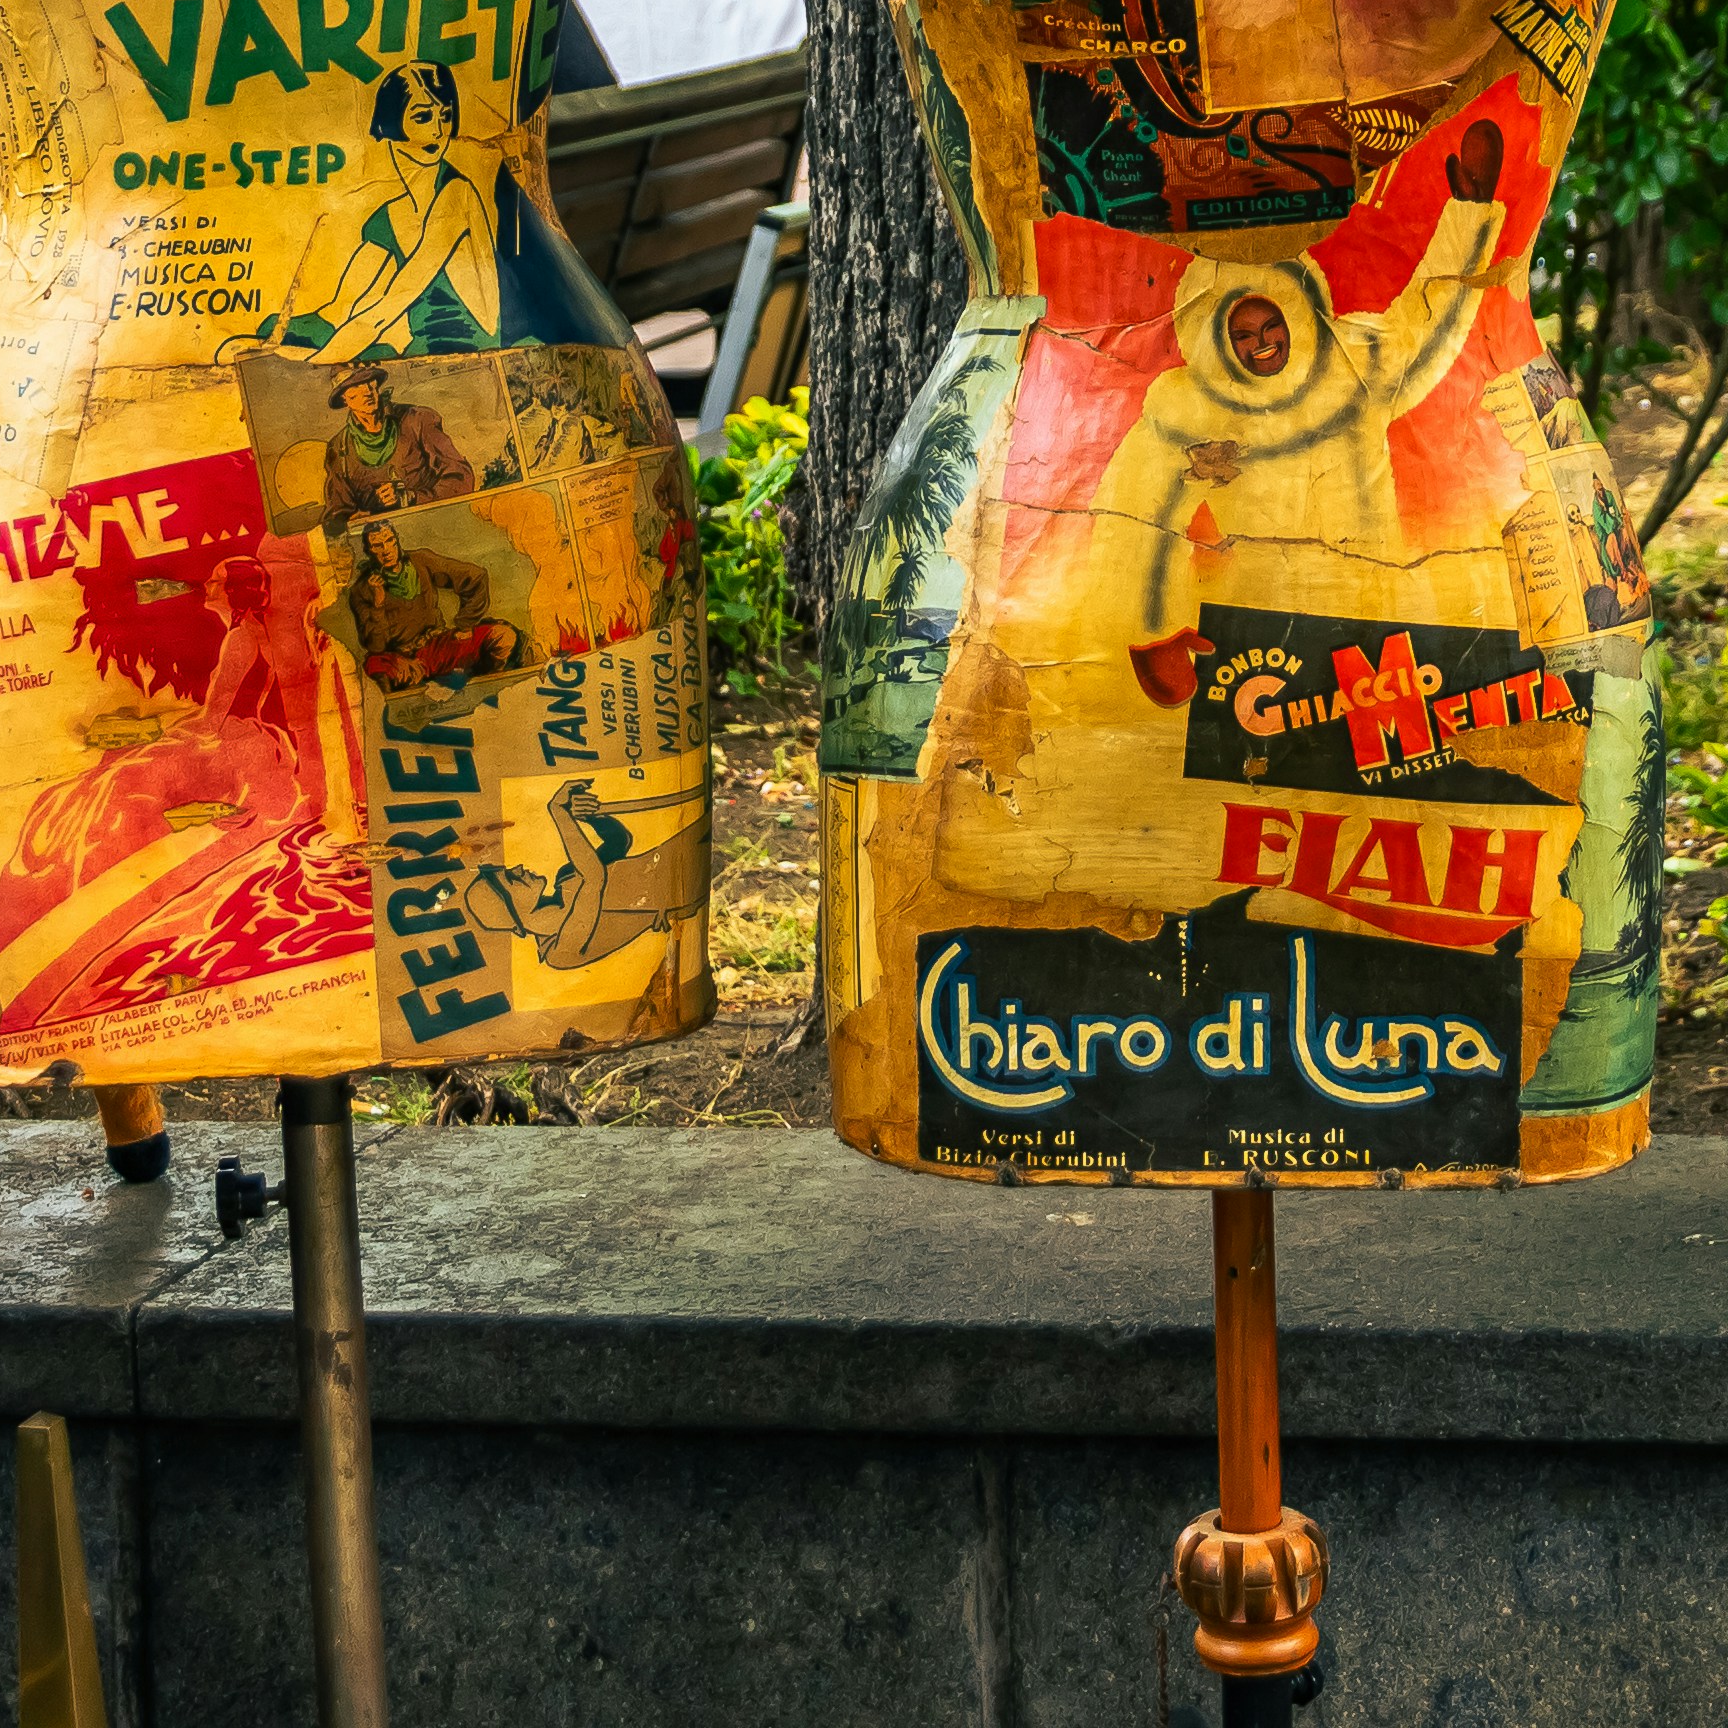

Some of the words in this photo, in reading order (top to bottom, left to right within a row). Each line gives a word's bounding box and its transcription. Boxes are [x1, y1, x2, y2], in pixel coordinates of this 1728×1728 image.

[25, 85, 55, 175] LIBERO
[112, 141, 347, 190] ONE-STEP
[1101, 148, 1145, 163] Piano
[1103, 169, 1143, 183] Chant
[1192, 193, 1308, 218] EDITIONS
[29, 182, 56, 259] BOVIO
[122, 216, 188, 232] VERSI
[196, 216, 217, 229] DI
[52, 229, 69, 259] 1928
[143, 238, 253, 259] CHERUBINI
[122, 262, 216, 286] MUSICA
[226, 261, 254, 281] DI
[1530, 556, 1556, 565] CAPO
[599, 650, 613, 671] DI
[7, 670, 54, 692] TORRES
[1208, 646, 1304, 703] BONBON
[653, 652, 680, 755] MUSICA
[1234, 663, 1443, 737] GHIACCIO
[1332, 631, 1577, 772] MENTA
[600, 690, 619, 736] VERSI
[1361, 771, 1382, 786] VI
[1212, 801, 1551, 947] ELAH
[47, 1017, 98, 1039] FRANCIS
[174, 989, 210, 1009] PARIS
[920, 936, 1171, 1110] Chiaro
[1192, 994, 1269, 1074] di
[1289, 935, 1505, 1108] Luna
[101, 1043, 122, 1054] VIA
[127, 1033, 156, 1049] CAPO
[237, 1005, 274, 1022] ROMA
[72, 1037, 96, 1050] PER
[982, 1128, 1042, 1145] Versi
[1054, 1130, 1076, 1145] di
[1228, 1128, 1312, 1146] Musica
[1324, 1127, 1346, 1144] di
[1009, 1150, 1127, 1167] Cherubini
[1242, 1149, 1373, 1167] RUSCONI
